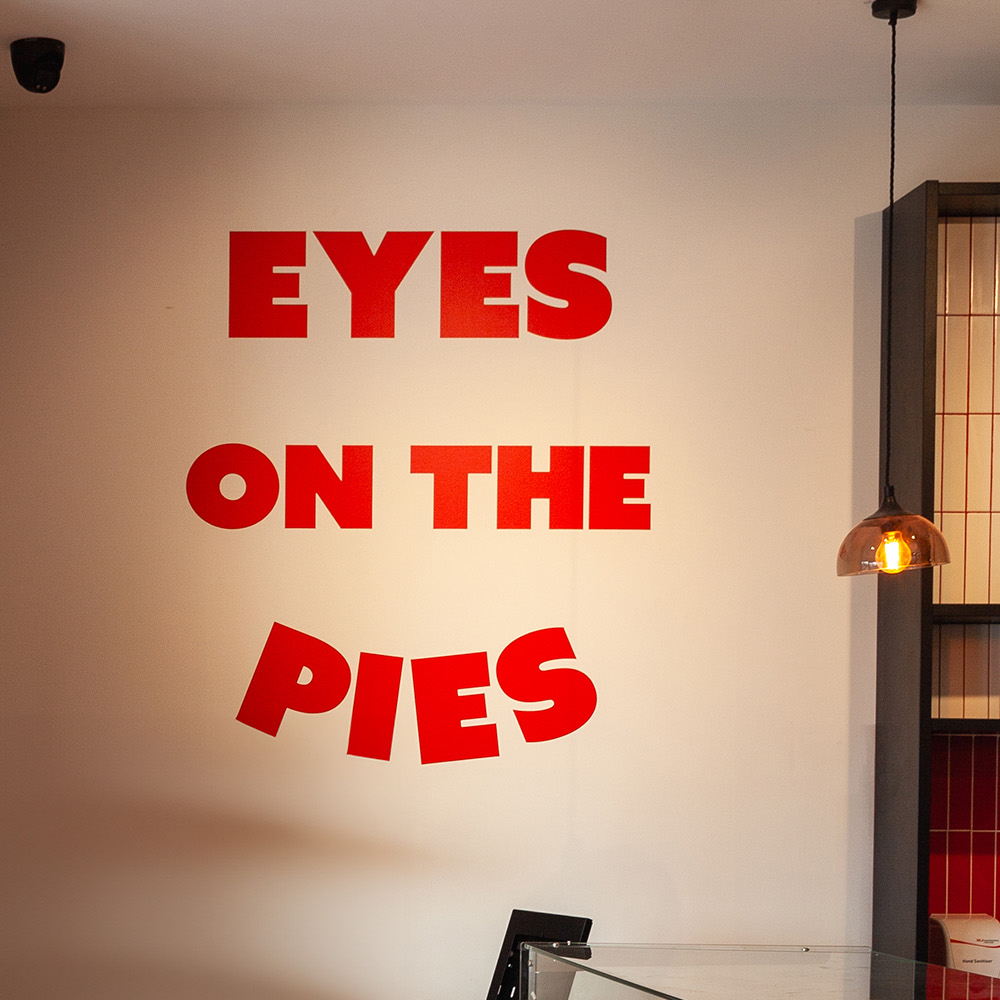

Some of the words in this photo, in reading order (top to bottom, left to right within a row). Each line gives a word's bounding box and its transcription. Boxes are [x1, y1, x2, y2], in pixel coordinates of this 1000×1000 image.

[228, 229, 613, 341] EYES
[185, 442, 374, 530] ON
[409, 444, 652, 531] THE
[235, 621, 598, 765] PIES
